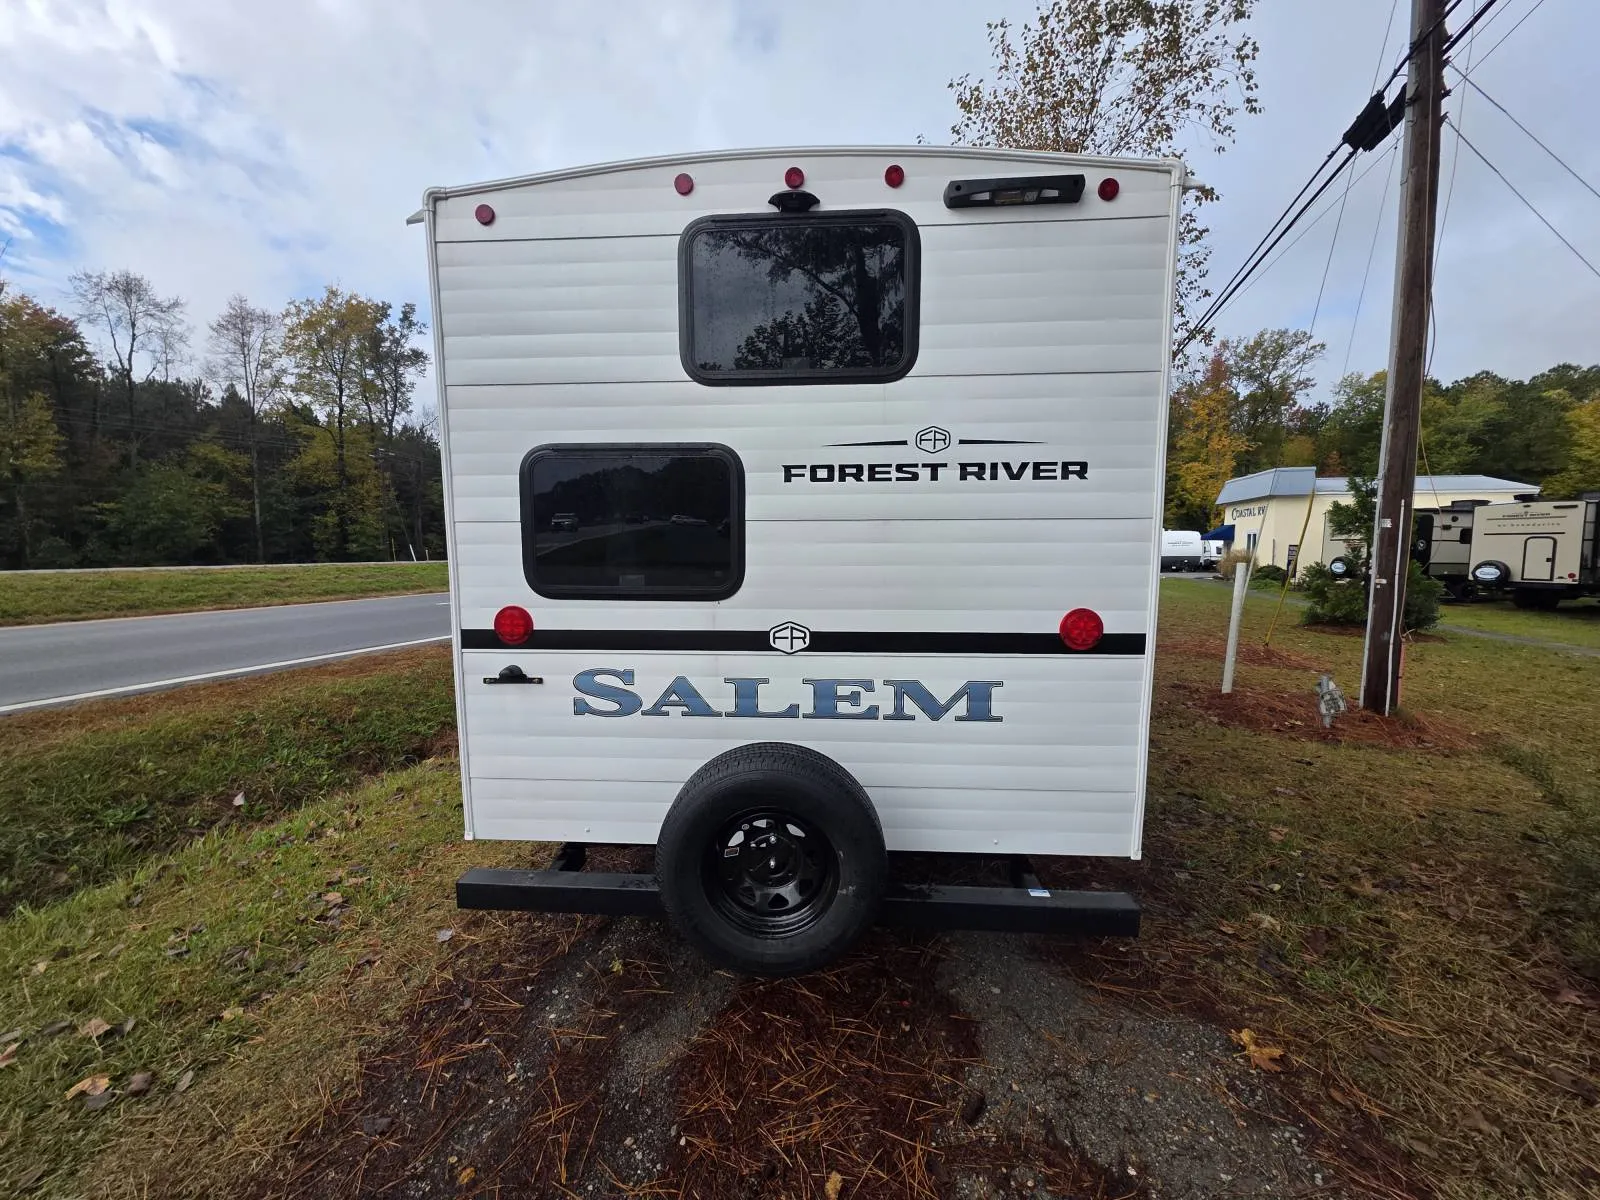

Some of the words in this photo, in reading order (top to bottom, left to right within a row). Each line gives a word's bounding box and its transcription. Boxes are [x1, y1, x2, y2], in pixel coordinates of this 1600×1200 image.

[781, 462, 948, 483] FOREST
[957, 460, 1089, 481] RIVER
[572, 667, 1005, 722] SALEM
